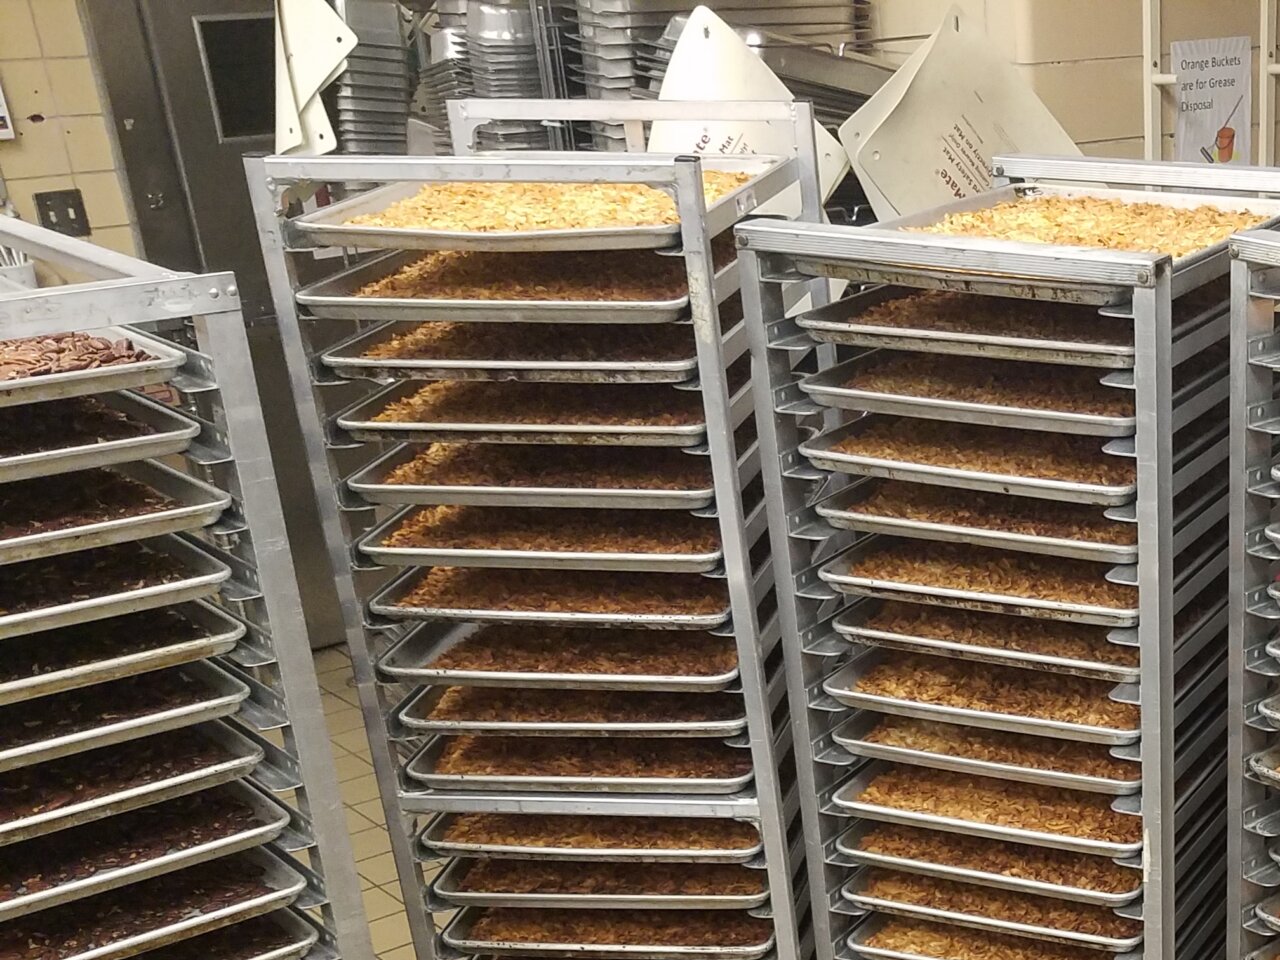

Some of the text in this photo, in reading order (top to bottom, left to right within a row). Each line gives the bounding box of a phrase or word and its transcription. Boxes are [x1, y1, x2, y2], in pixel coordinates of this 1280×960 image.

[1180, 56, 1241, 71] Orange Buckets
[1181, 77, 1236, 92] are for Grease
[1181, 99, 1214, 113] Disposal
[953, 123, 965, 140] Mat
[943, 147, 955, 164] Mat
[955, 161, 973, 186] Safety
